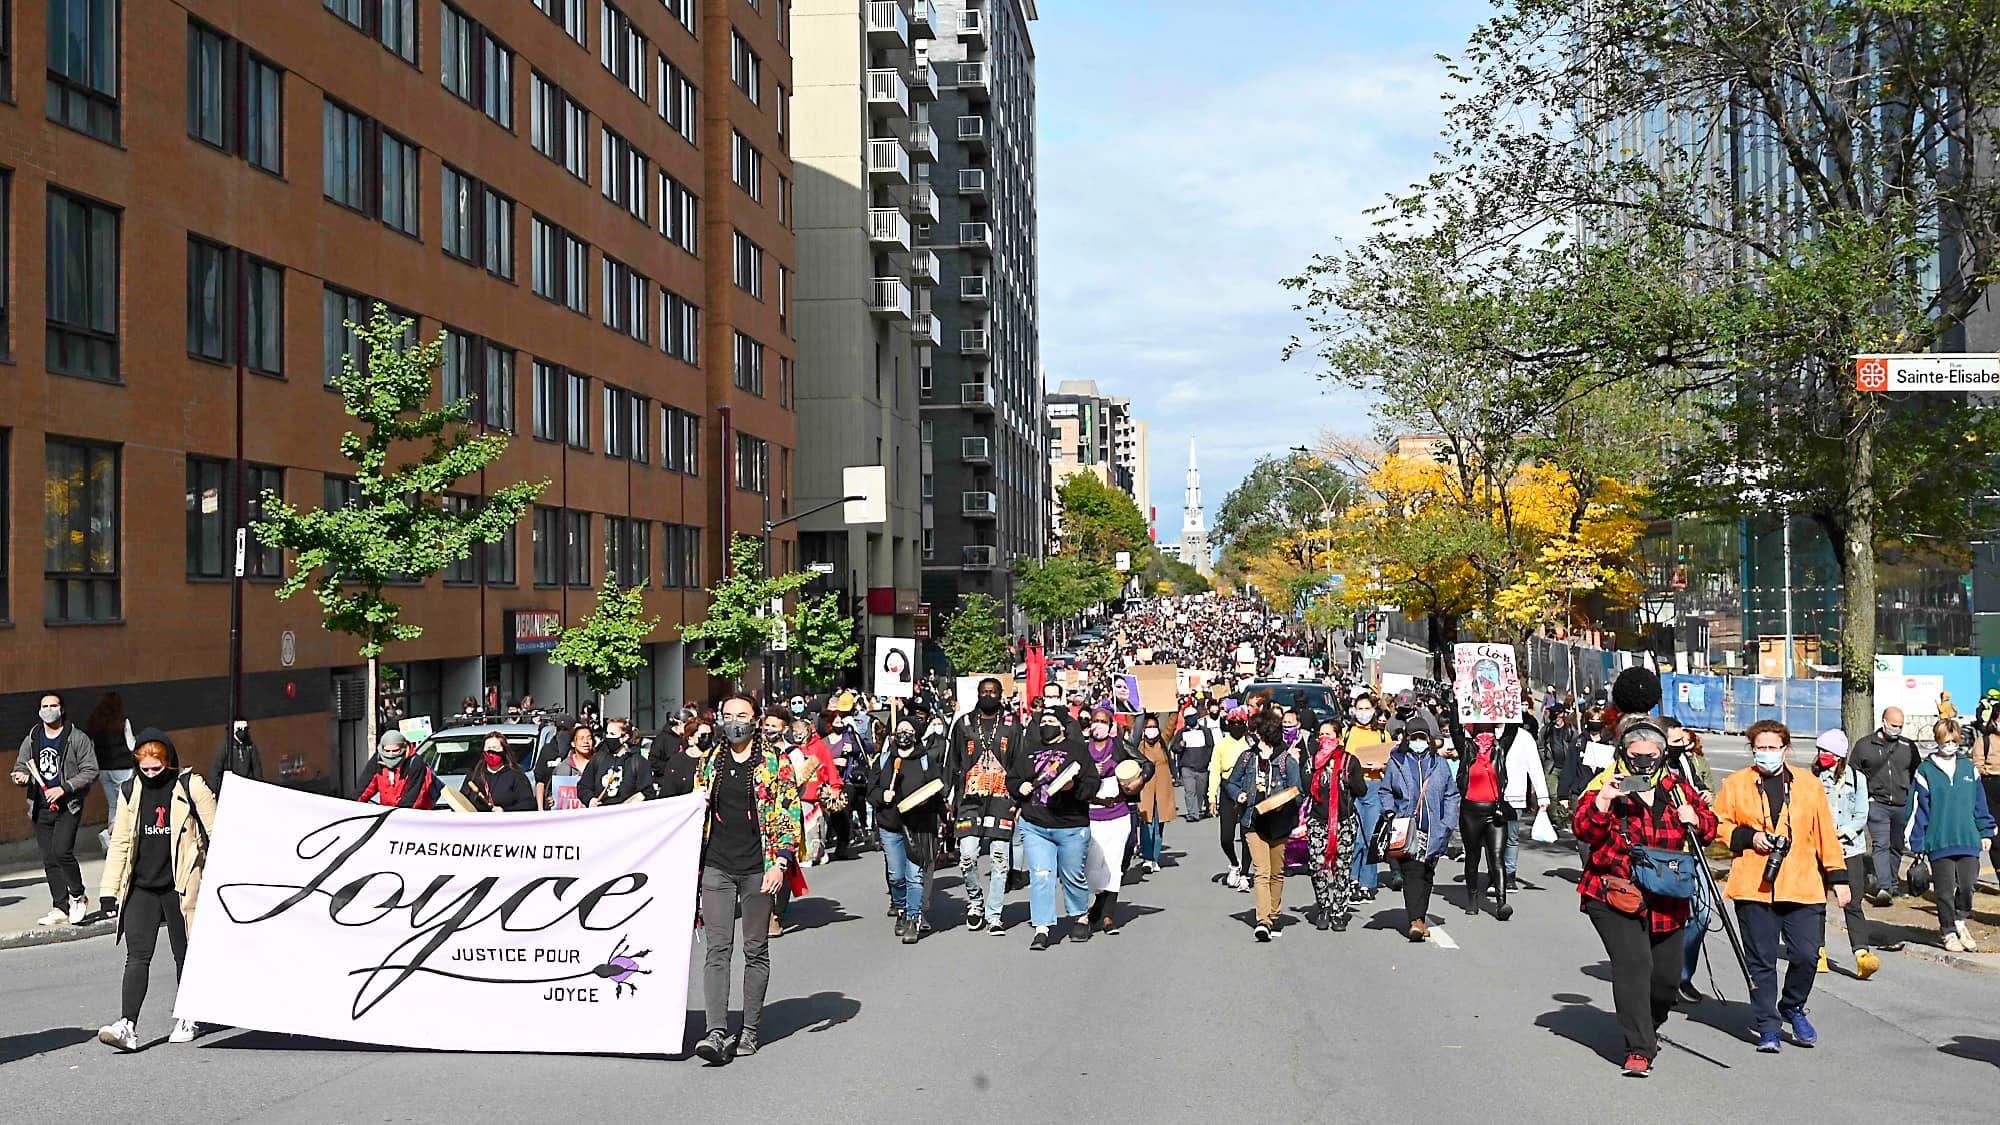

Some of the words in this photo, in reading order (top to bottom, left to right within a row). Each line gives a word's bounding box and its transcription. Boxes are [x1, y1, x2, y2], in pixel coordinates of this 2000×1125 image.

[389, 841, 537, 860] TIPASKONIKEWIN
[543, 845, 580, 861] OTCI
[217, 807, 654, 1019] Joyce
[452, 948, 527, 962] JUSTICE
[534, 949, 580, 964] POUR
[543, 987, 599, 1003] JOYCE
